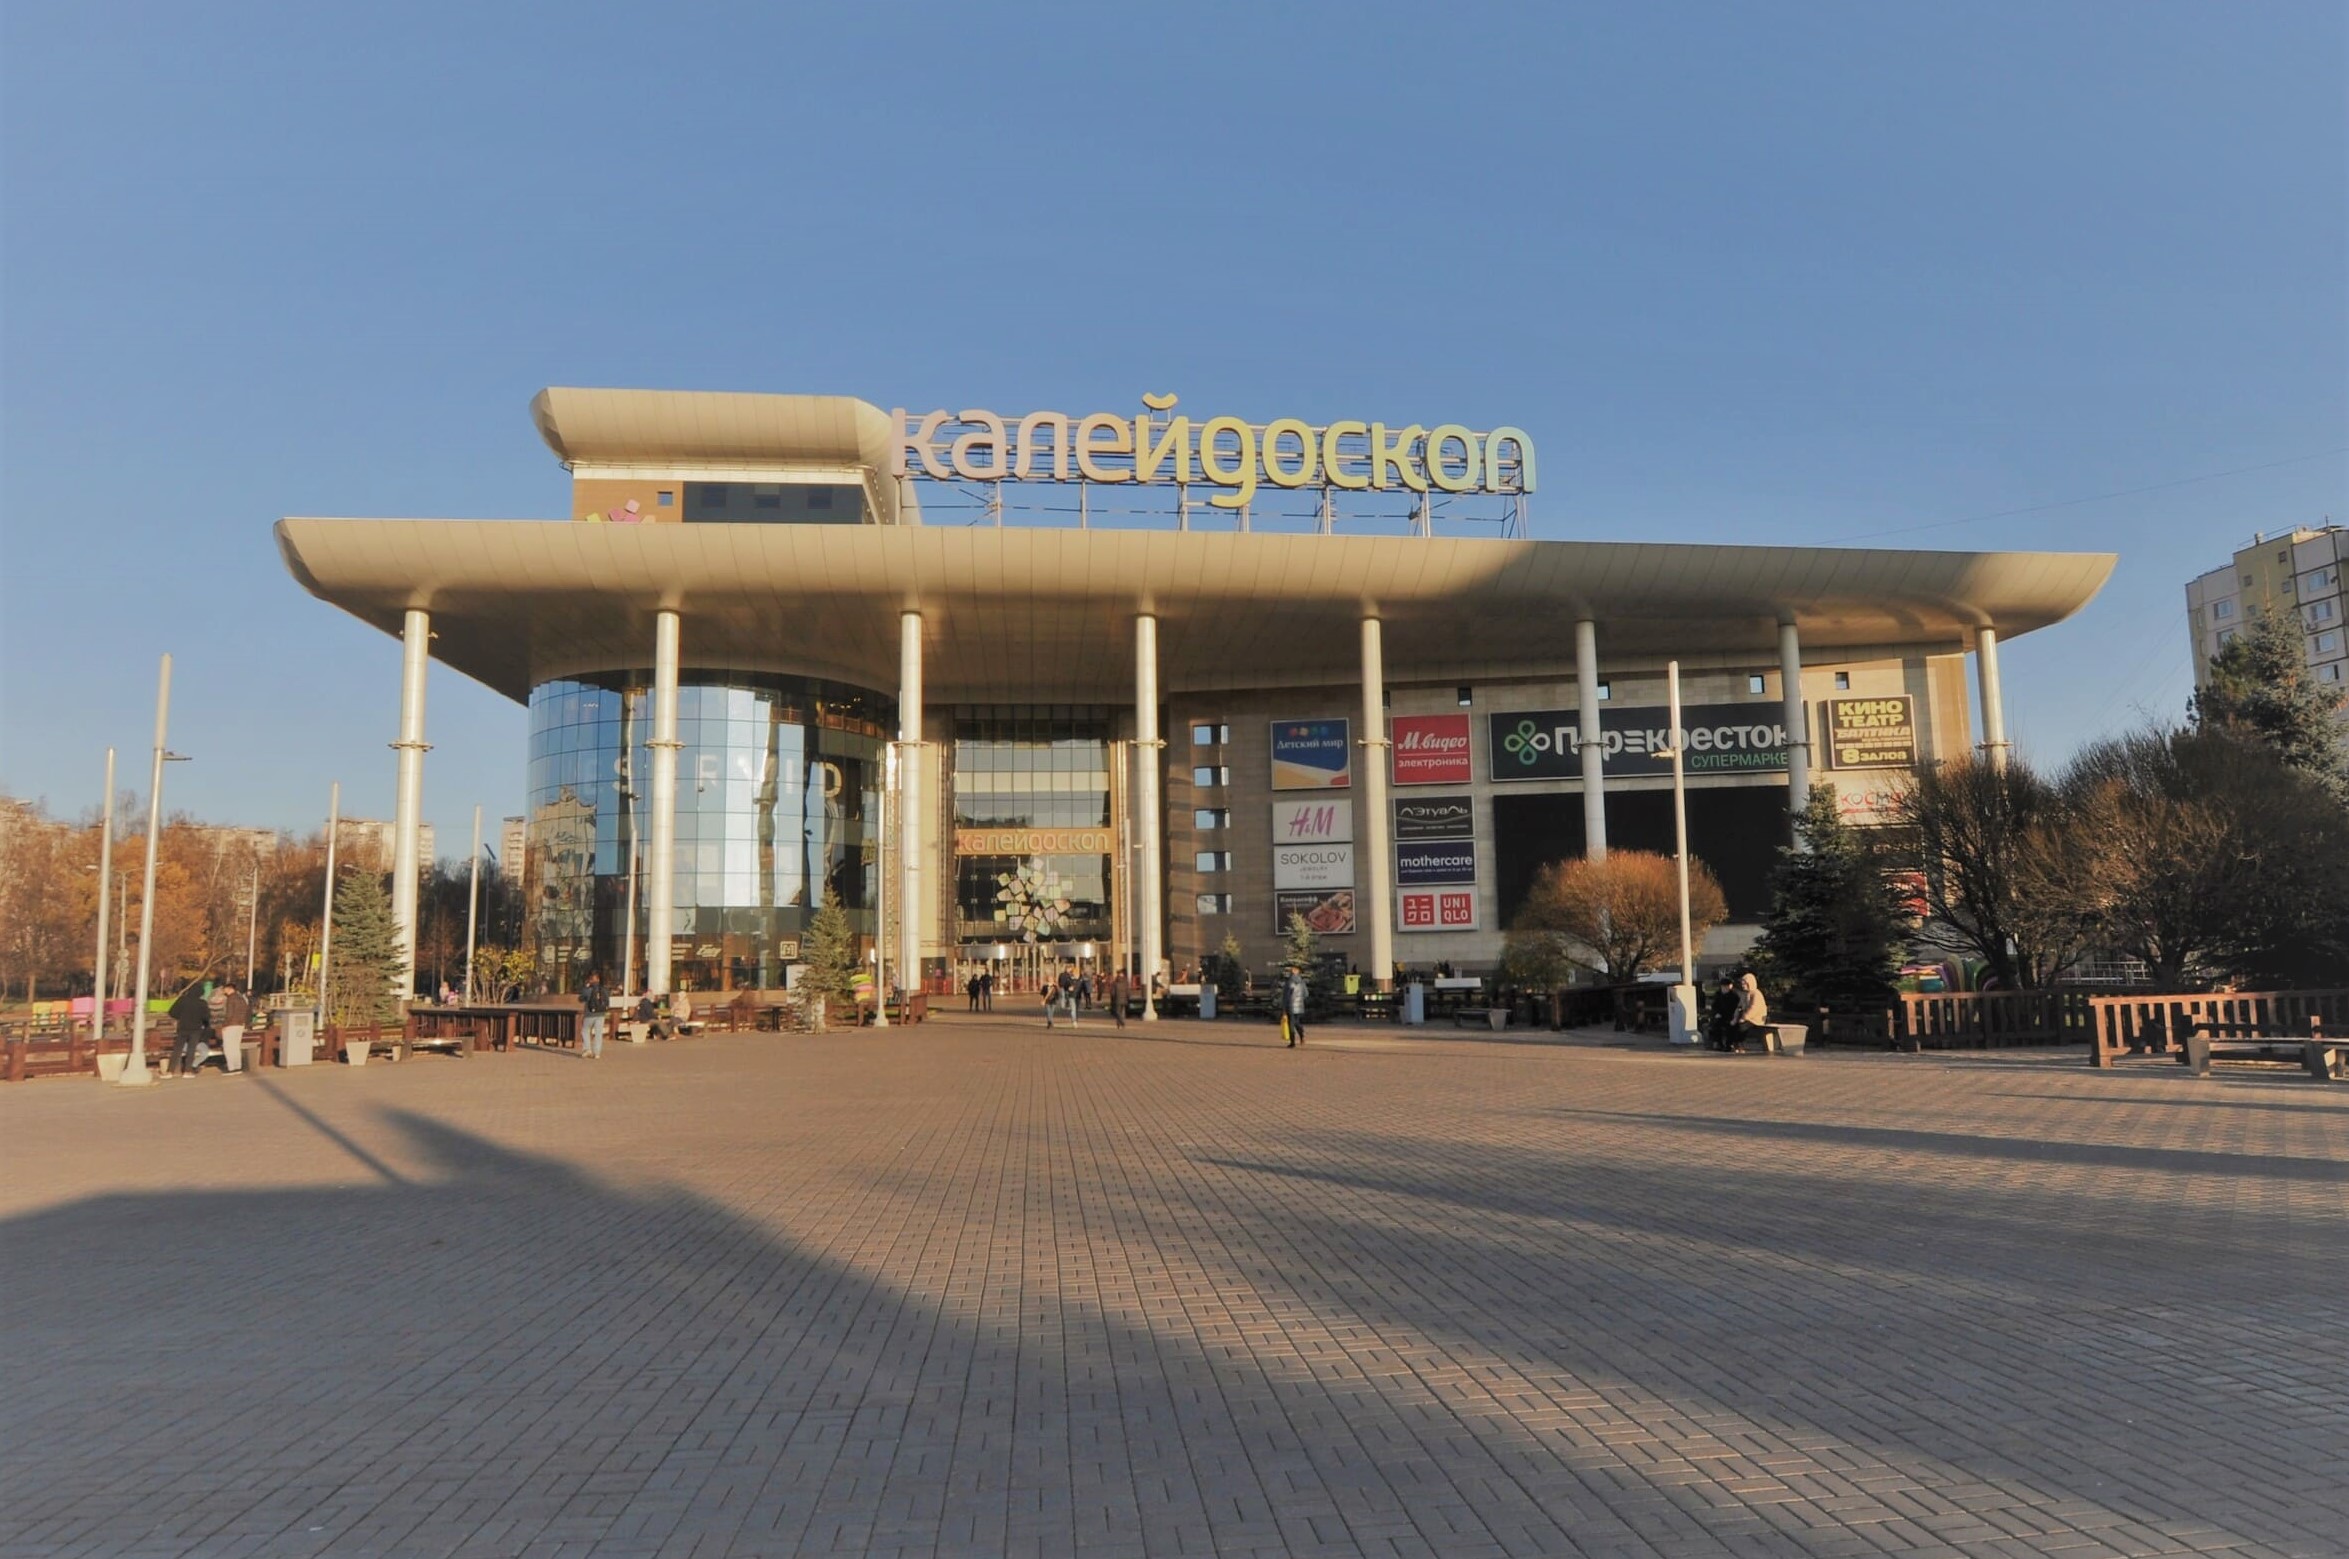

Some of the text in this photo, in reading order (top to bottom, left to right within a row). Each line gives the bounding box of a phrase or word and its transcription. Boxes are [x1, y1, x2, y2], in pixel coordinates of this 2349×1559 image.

[891, 393, 1538, 508] калейдоскоп
[1838, 701, 1904, 715] КИНО
[1839, 714, 1905, 728] ТЕАТР
[1277, 739, 1343, 749] Детский мир
[1691, 753, 1788, 768] СУПЕРМАРКЕ
[1842, 748, 1907, 764] 8 ЗАЛОВ
[1399, 758, 1468, 770] электроника
[1288, 805, 1334, 837] H&M
[958, 829, 1109, 856] калейдоскоп
[1280, 852, 1346, 865] SOKOLOV
[1400, 855, 1473, 867] mothercare
